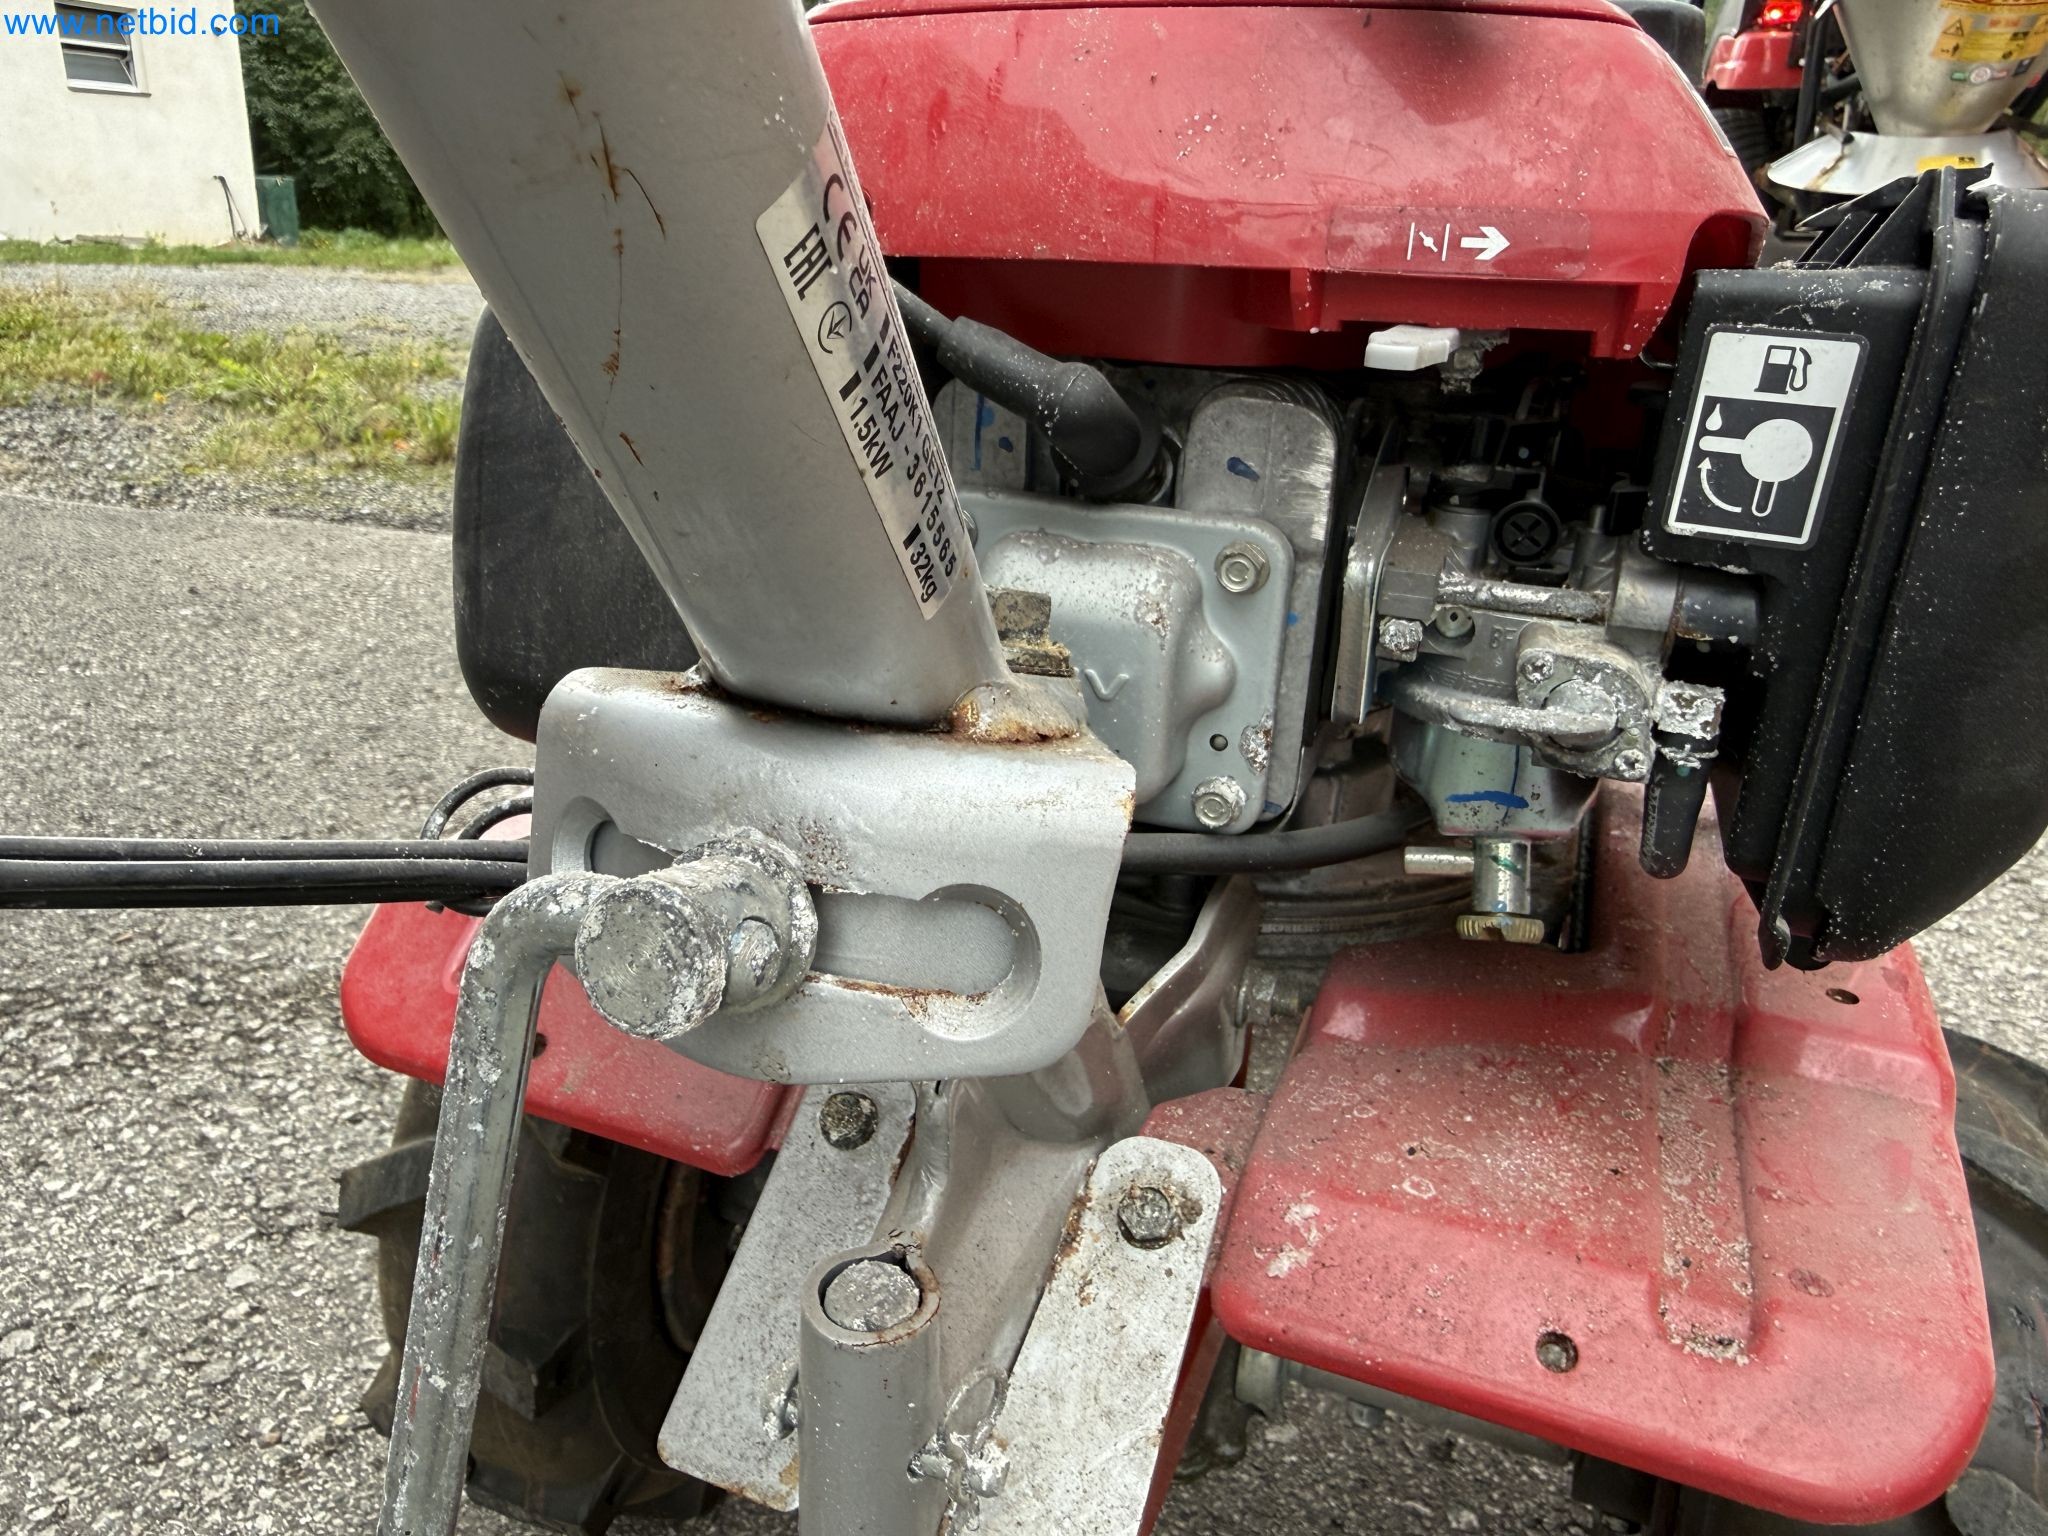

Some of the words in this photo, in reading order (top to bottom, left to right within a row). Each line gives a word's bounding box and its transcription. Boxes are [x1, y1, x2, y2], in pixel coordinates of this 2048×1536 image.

[823, 173, 857, 262] CE
[850, 397, 894, 480] 1.5kW
[910, 542, 937, 604] 32kg
